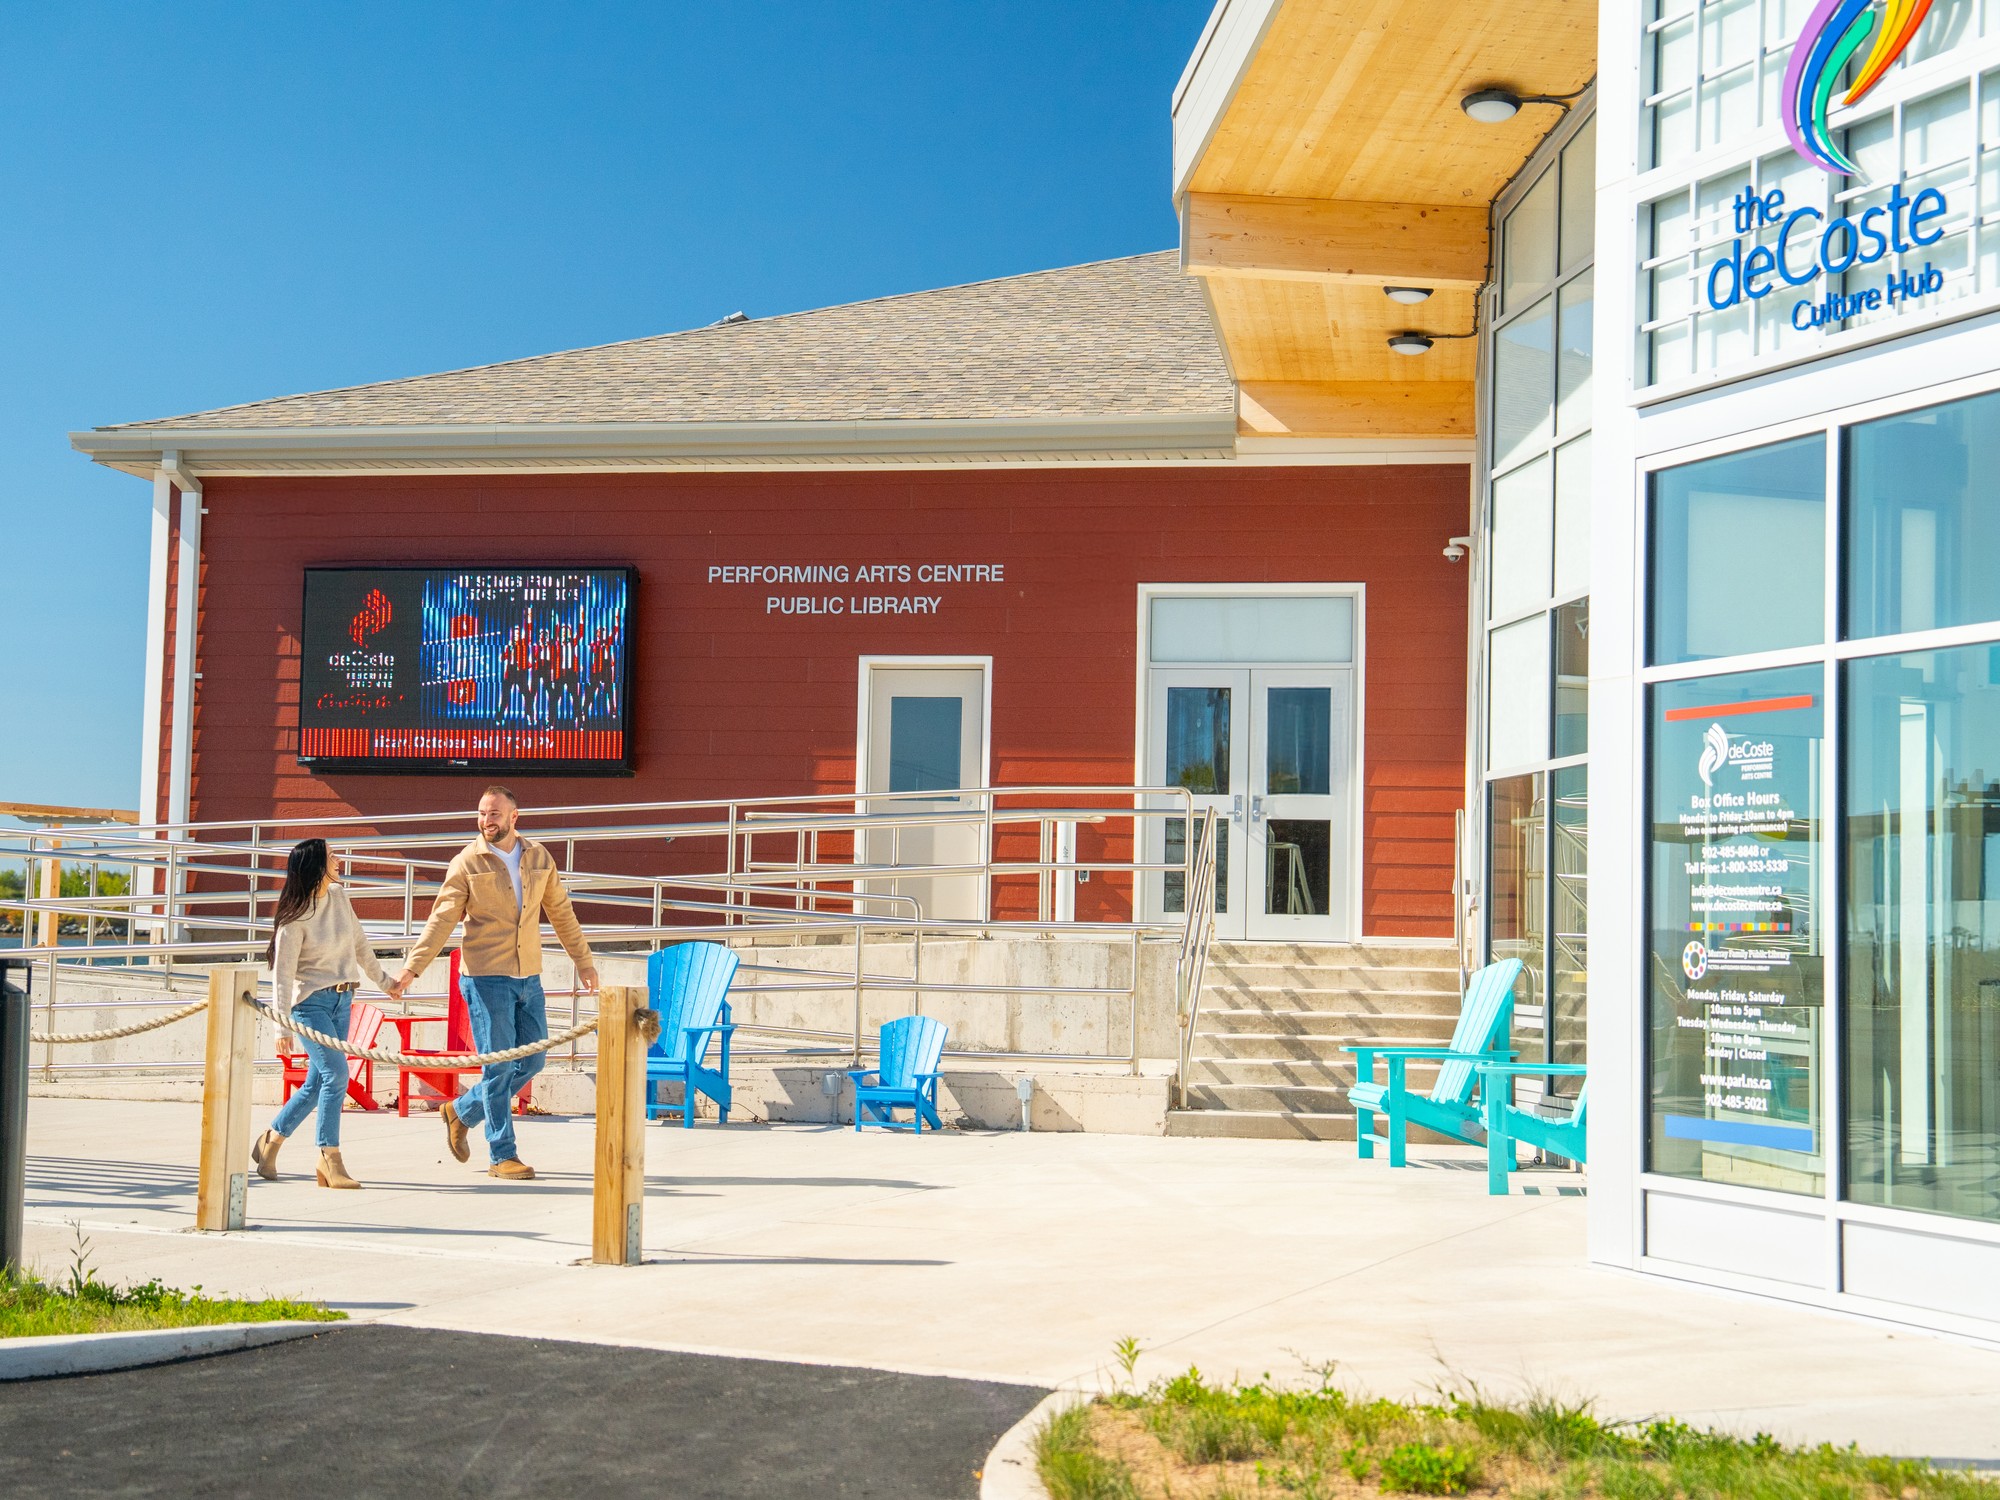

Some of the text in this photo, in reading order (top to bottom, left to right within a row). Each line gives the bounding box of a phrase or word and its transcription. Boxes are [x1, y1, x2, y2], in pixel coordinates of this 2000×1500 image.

[1733, 185, 1784, 233] the
[1707, 184, 1946, 310] deCoste
[1792, 262, 1943, 331] Culture Hub
[708, 564, 1004, 583] PERFORMING ARTS CENTRE
[766, 596, 942, 614] PUBLIC LIBRARY
[1728, 740, 1774, 759] deCoste
[1691, 791, 1780, 809] Box Office Hours
[1679, 813, 1707, 825] Monday
[1710, 813, 1718, 822] to
[1767, 810, 1776, 819] to
[1777, 808, 1795, 821] 4pm
[1702, 845, 1770, 859] 902-485-8848 or
[1685, 861, 1699, 874] Toll
[1700, 862, 1720, 874] Free:
[1687, 988, 1785, 1005] Monday, Friday, Saturday
[1710, 1003, 1761, 1017] 10am to 5pm
[1677, 1016, 1797, 1034] Tuesday, Wednesday, Thursday
[1710, 1032, 1731, 1043] 10am
[1733, 1034, 1742, 1044] to
[1705, 1046, 1733, 1060] Sunday
[1739, 1048, 1766, 1060] Closed
[1700, 1073, 1772, 1090] www.parl.ns.ca
[1705, 1092, 1768, 1111] 902-485-5021
